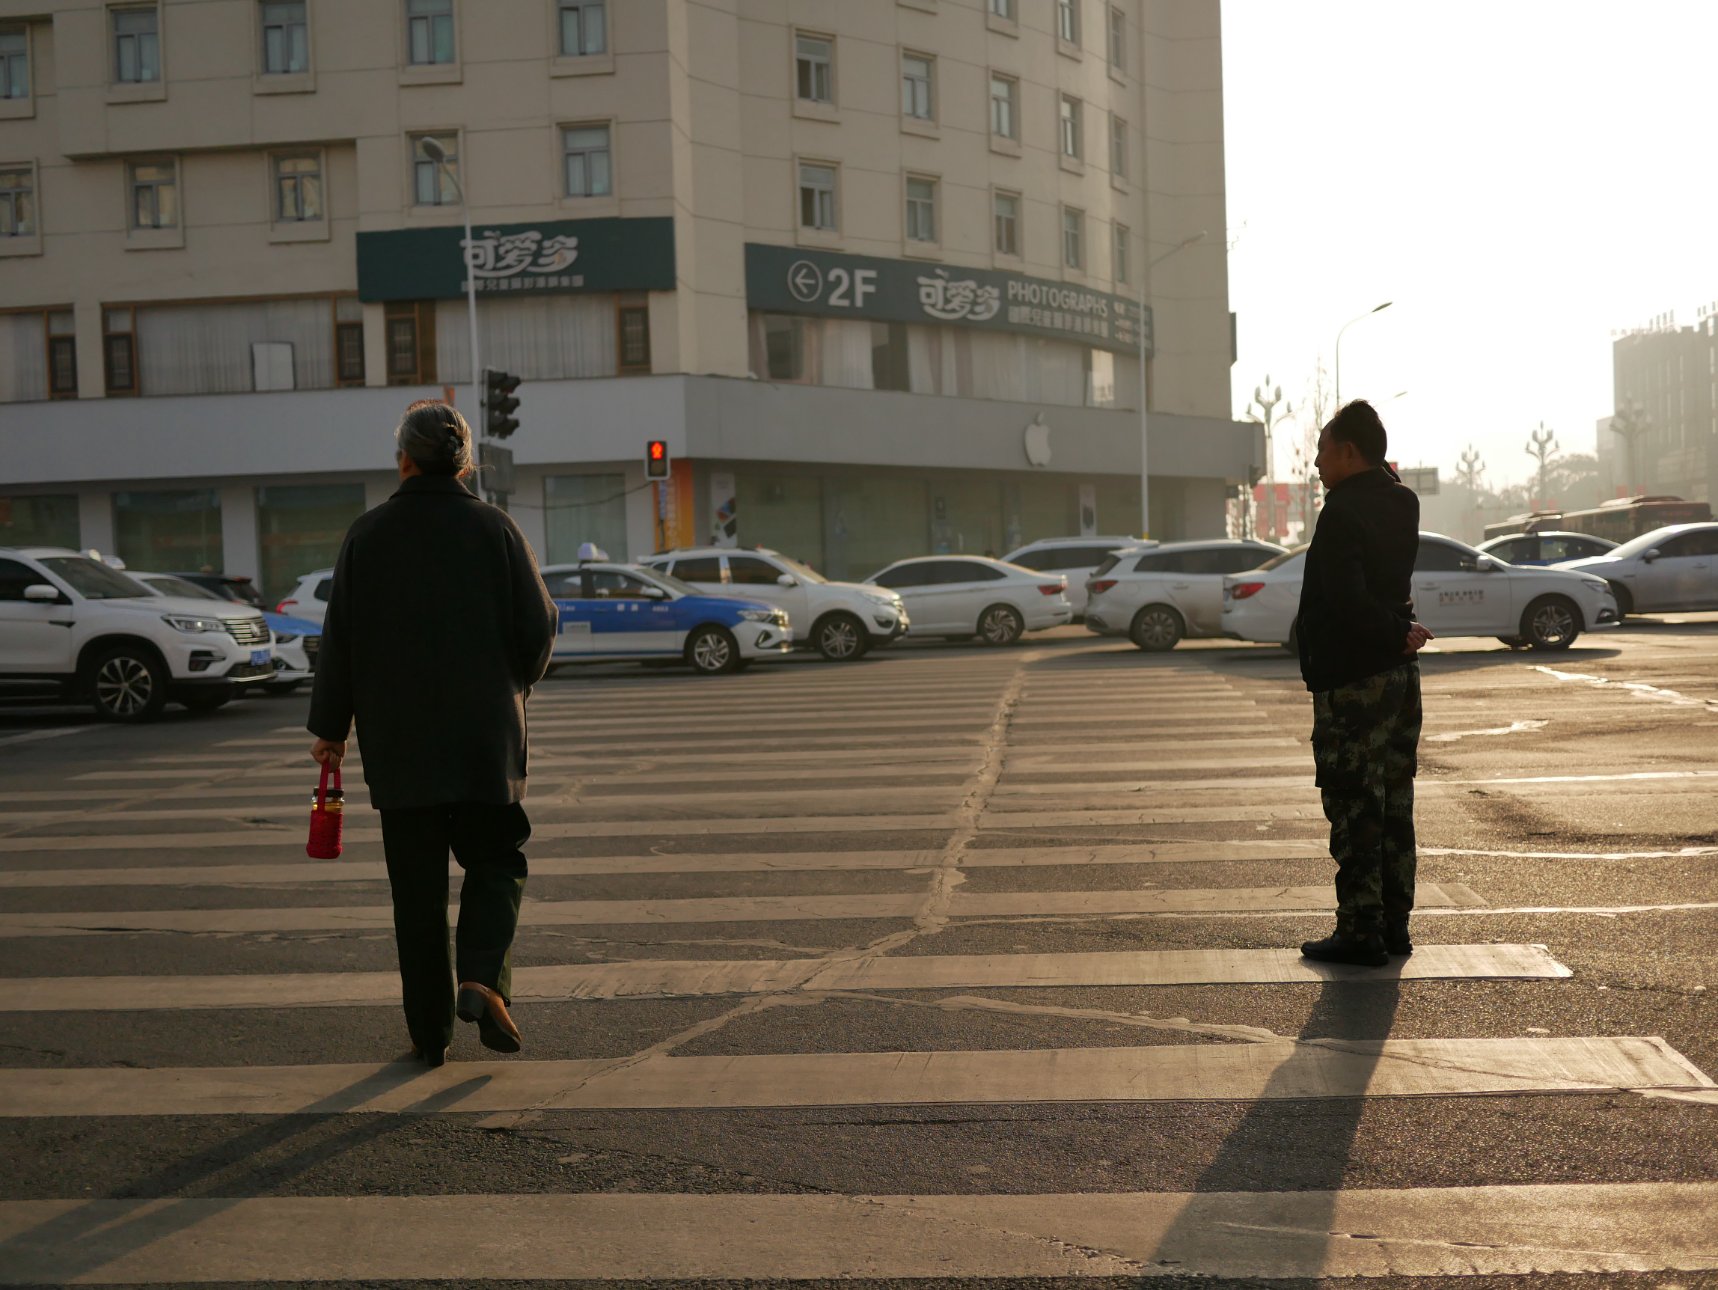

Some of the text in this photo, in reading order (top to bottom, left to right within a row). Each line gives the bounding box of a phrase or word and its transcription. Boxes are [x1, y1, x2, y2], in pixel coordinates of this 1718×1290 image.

[827, 268, 878, 308] 2F
[916, 268, 1001, 321] 可爱多
[1007, 280, 1109, 318] PHOTOGRAPHS
